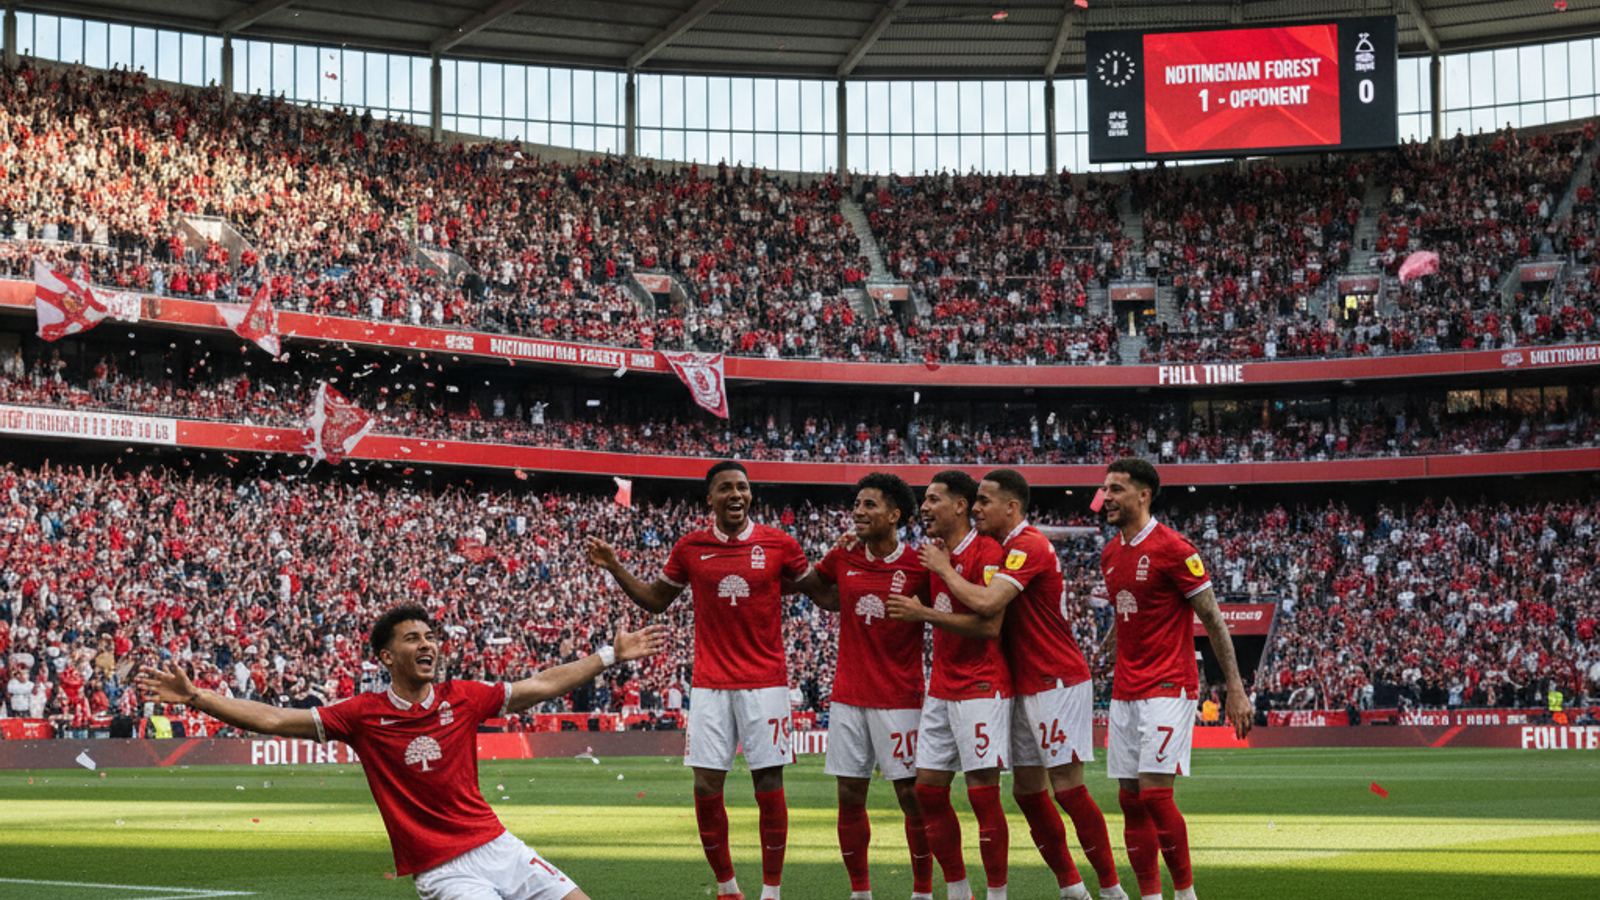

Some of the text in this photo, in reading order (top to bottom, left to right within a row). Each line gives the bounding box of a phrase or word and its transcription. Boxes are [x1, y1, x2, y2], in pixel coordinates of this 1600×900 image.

[1264, 58, 1321, 79] FOREST
[1198, 88, 1209, 112] 1
[1230, 85, 1310, 108] OPPONENT
[1359, 79, 1374, 103] 0
[975, 722, 989, 750] 5
[1157, 726, 1174, 754] 7
